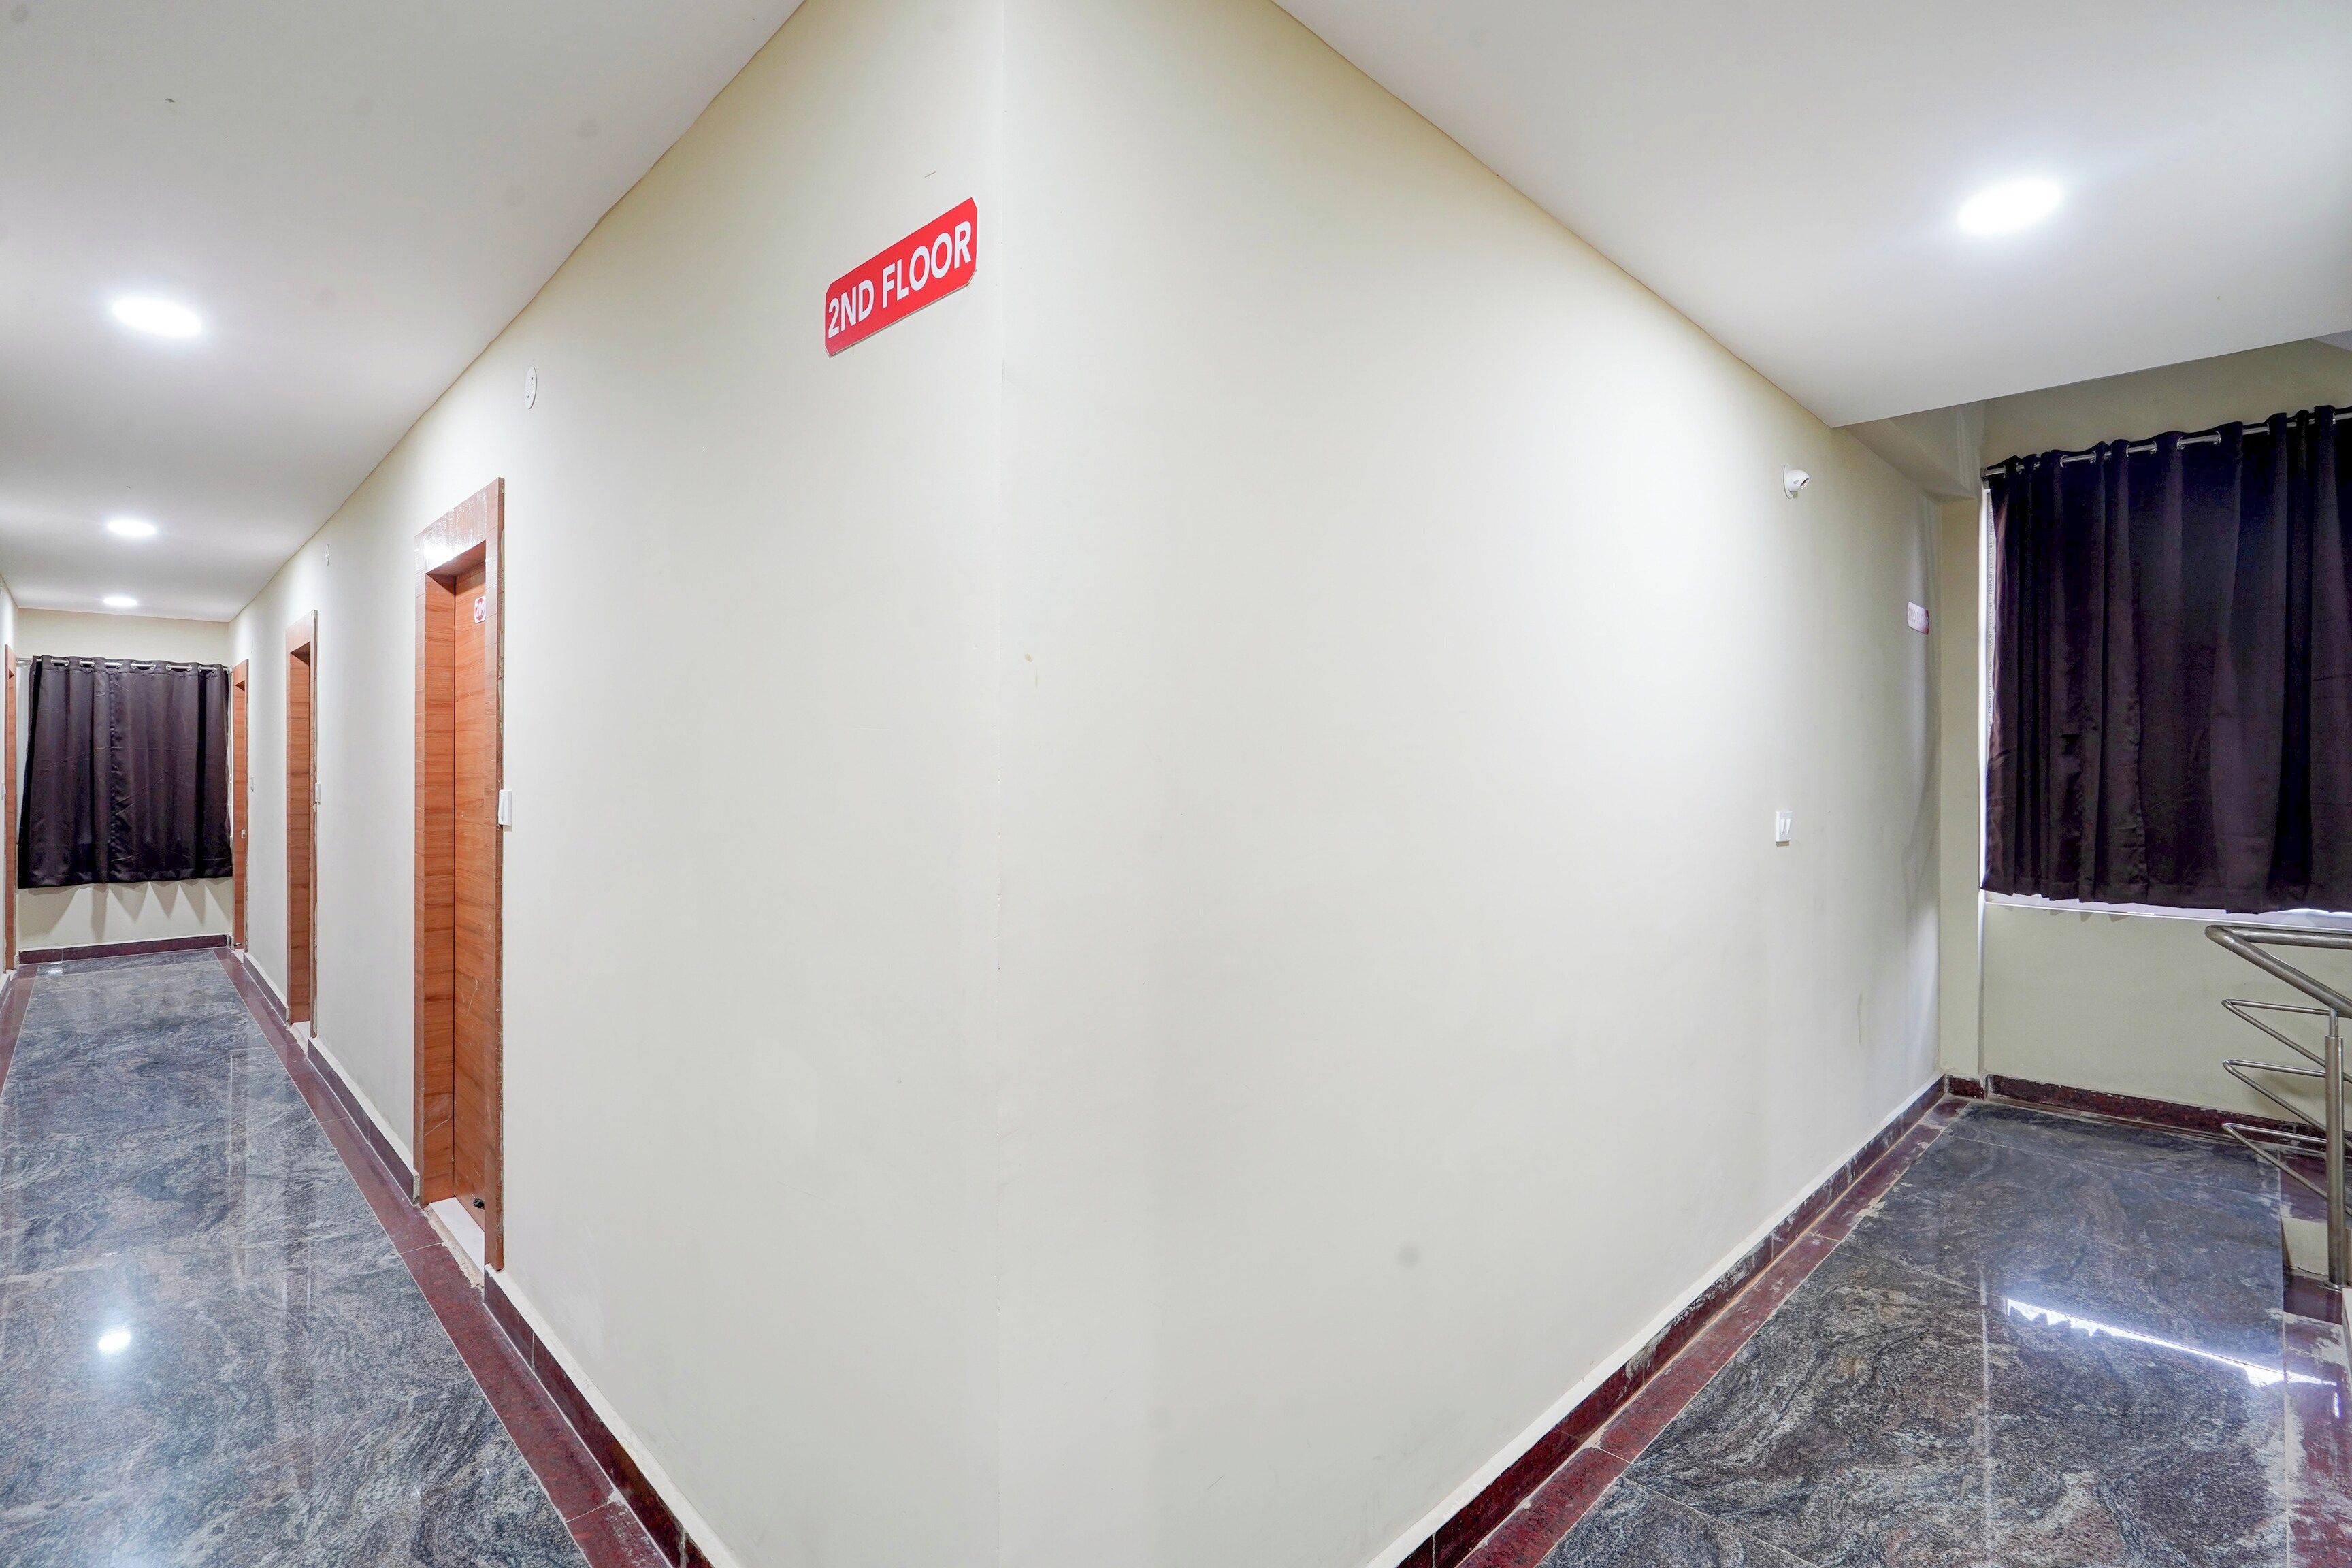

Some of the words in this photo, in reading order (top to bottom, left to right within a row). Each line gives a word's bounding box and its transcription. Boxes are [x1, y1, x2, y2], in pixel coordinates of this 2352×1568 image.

[828, 279, 874, 338] 2ND
[883, 220, 972, 308] FLOOR
[476, 601, 485, 617] 209
